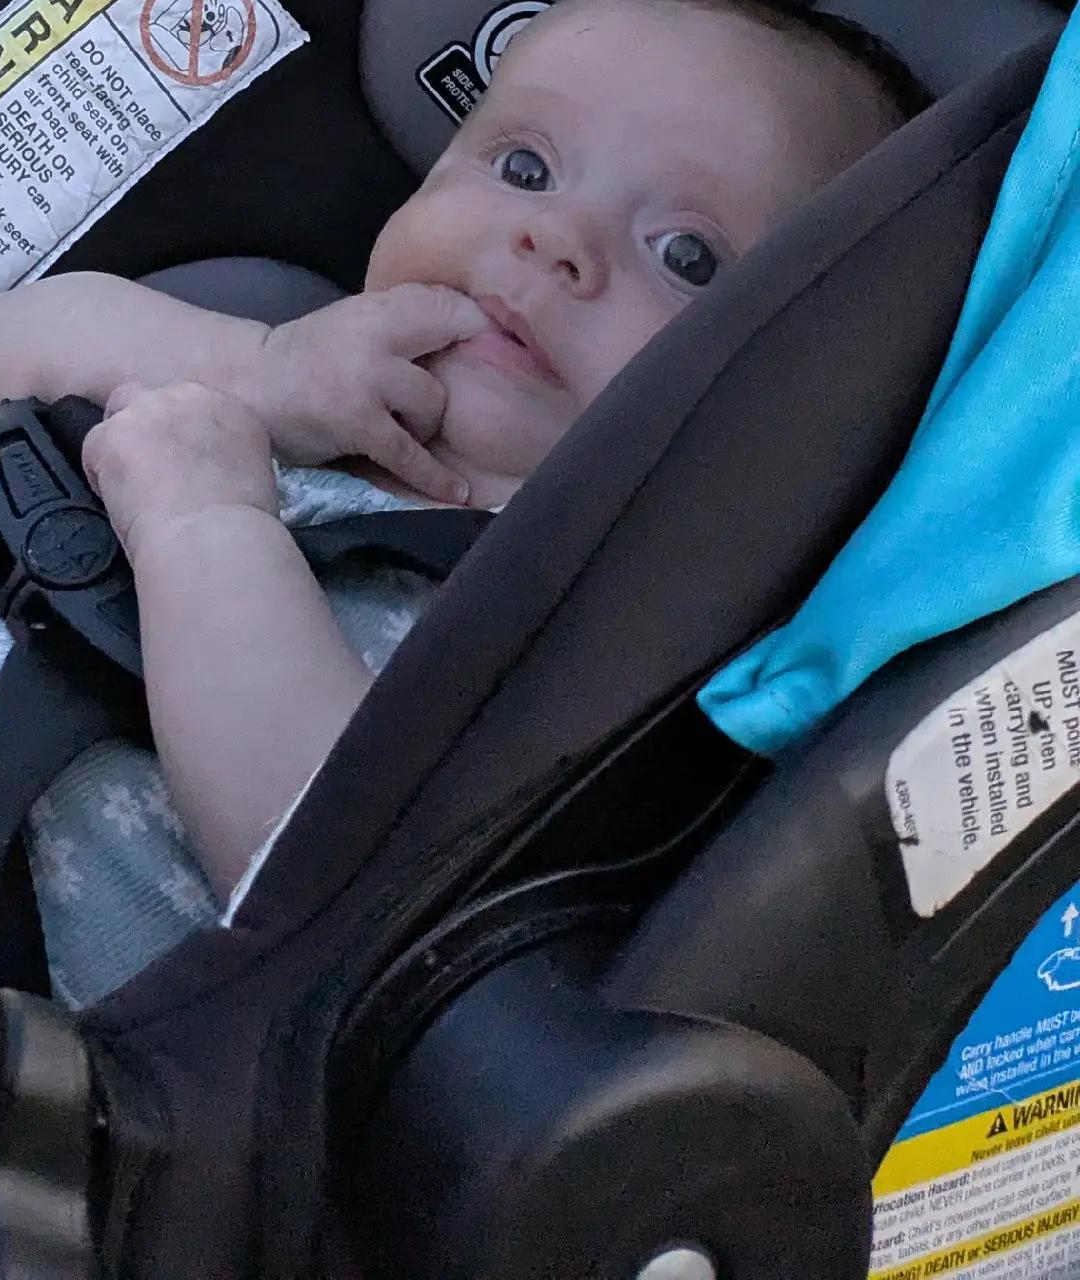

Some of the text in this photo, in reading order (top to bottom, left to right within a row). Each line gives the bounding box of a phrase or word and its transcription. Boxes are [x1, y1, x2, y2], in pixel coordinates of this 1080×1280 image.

[23, 87, 69, 143] air bag.
[51, 63, 129, 156] child seat on
[64, 50, 131, 132] rear-facing
[79, 39, 162, 142] DO NOT place
[451, 68, 474, 92] SIDE
[6, 99, 76, 183] DEATH OR
[37, 73, 124, 179] front seat with
[3, 222, 36, 256] seat
[27, 185, 52, 215] can
[1056, 650, 1080, 708] MUST
[974, 686, 1008, 836] when installed
[1003, 680, 1033, 809] carrying and
[1032, 680, 1056, 770] UP hen
[947, 707, 981, 851] in the vehicle.
[1035, 1010, 1070, 1034] MUST
